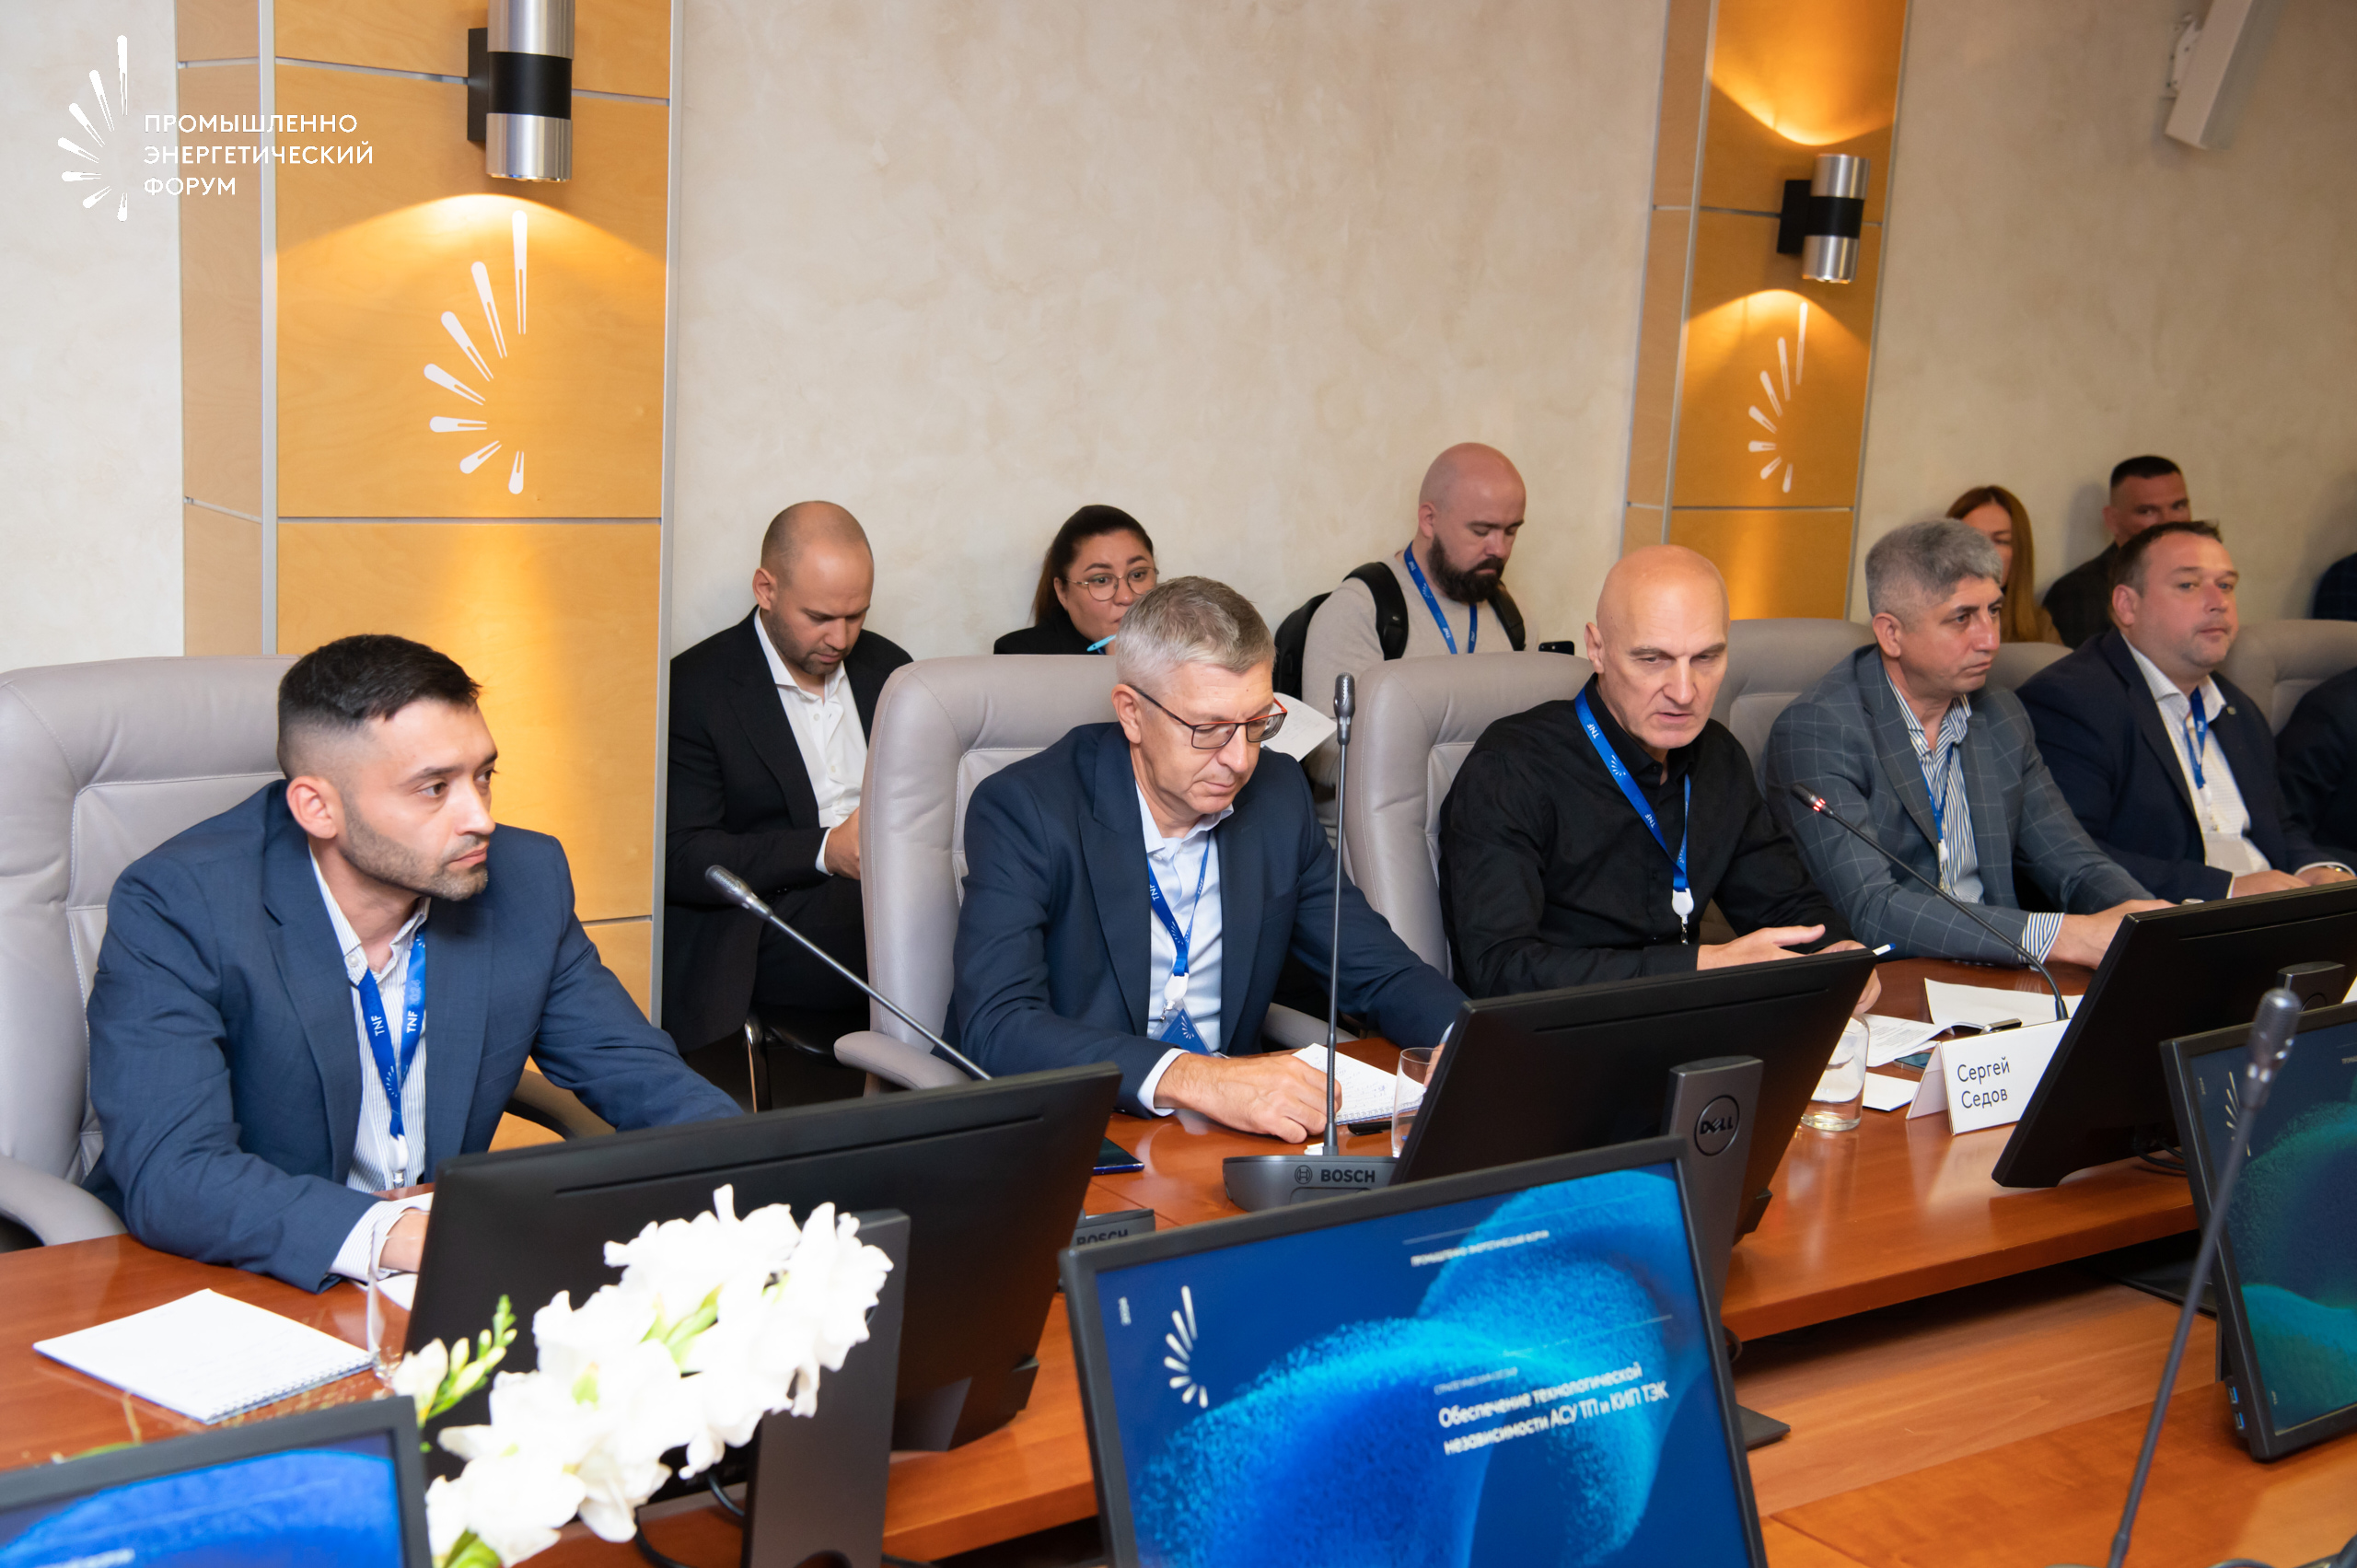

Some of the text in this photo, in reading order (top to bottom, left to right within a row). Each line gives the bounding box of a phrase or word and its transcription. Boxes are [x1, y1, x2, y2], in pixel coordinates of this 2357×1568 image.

[1586, 723, 1600, 739] TNF
[1644, 813, 1656, 829] TNF
[371, 1016, 385, 1037] TNF
[406, 1010, 418, 1033] TNF
[1956, 1056, 2010, 1085] Сергей
[1961, 1088, 2008, 1109] Седов
[1700, 1116, 1734, 1135] DELL
[1320, 1168, 1376, 1184] BOSCH
[1438, 1392, 1532, 1428] Обеспечение
[1532, 1361, 1643, 1404] технологической
[1443, 1380, 1670, 1456] независимости АСУ ТП и КИП ТЭК
